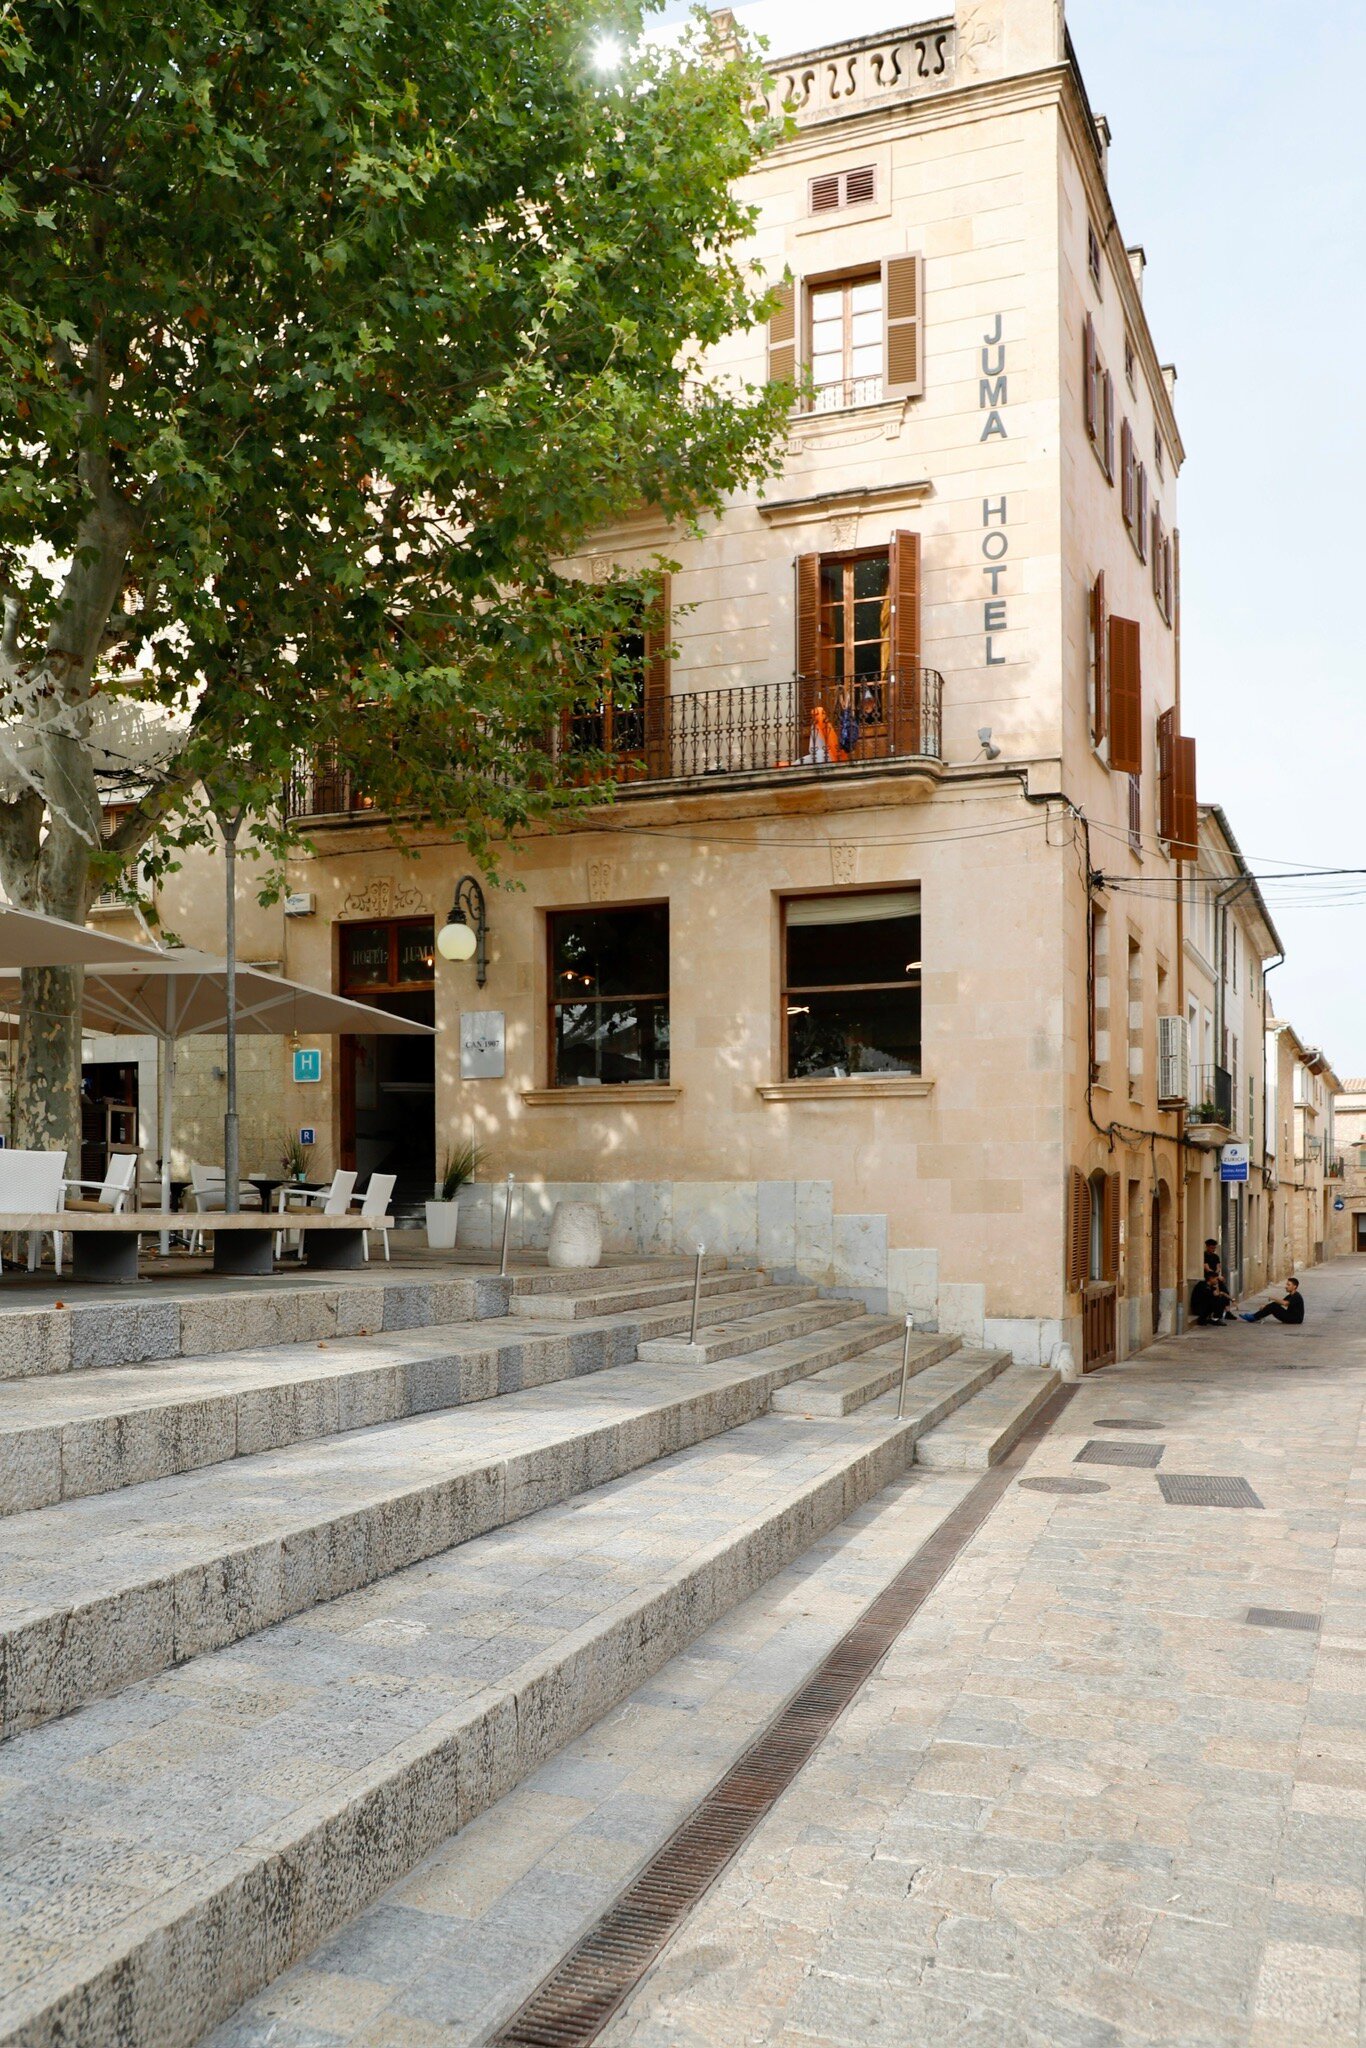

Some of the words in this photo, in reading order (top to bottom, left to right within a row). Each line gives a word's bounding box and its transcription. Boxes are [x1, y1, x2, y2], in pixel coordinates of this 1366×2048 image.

[979, 313, 1008, 442] JUMA
[981, 496, 1008, 666] HOTEL
[301, 1054, 312, 1070] H
[303, 1131, 311, 1140] R
